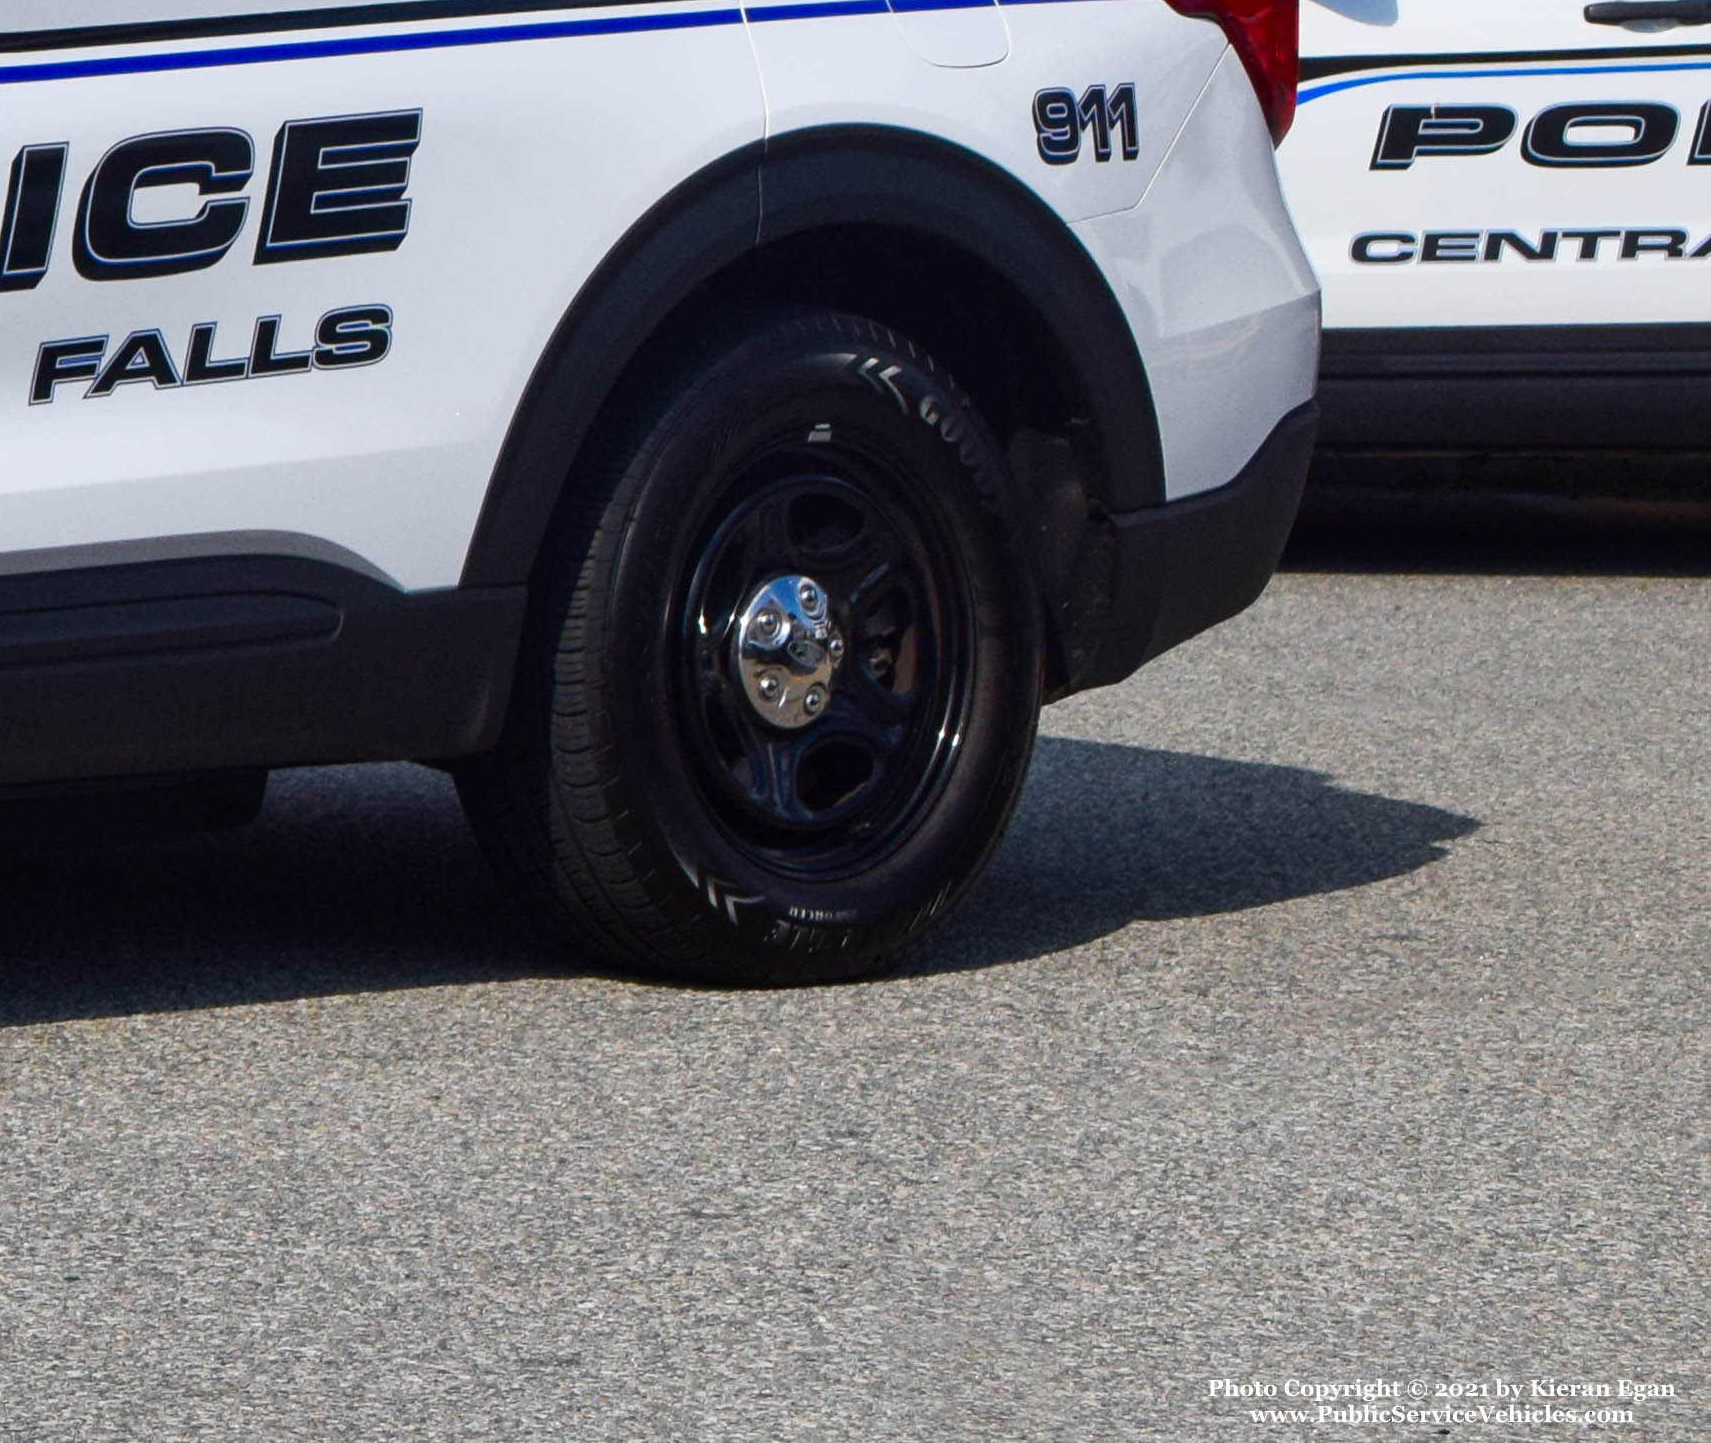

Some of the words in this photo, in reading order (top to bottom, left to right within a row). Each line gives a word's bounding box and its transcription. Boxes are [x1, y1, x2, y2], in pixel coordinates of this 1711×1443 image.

[1032, 82, 1139, 166] 911
[1369, 100, 1711, 171] PO
[28, 304, 394, 406] FALLS
